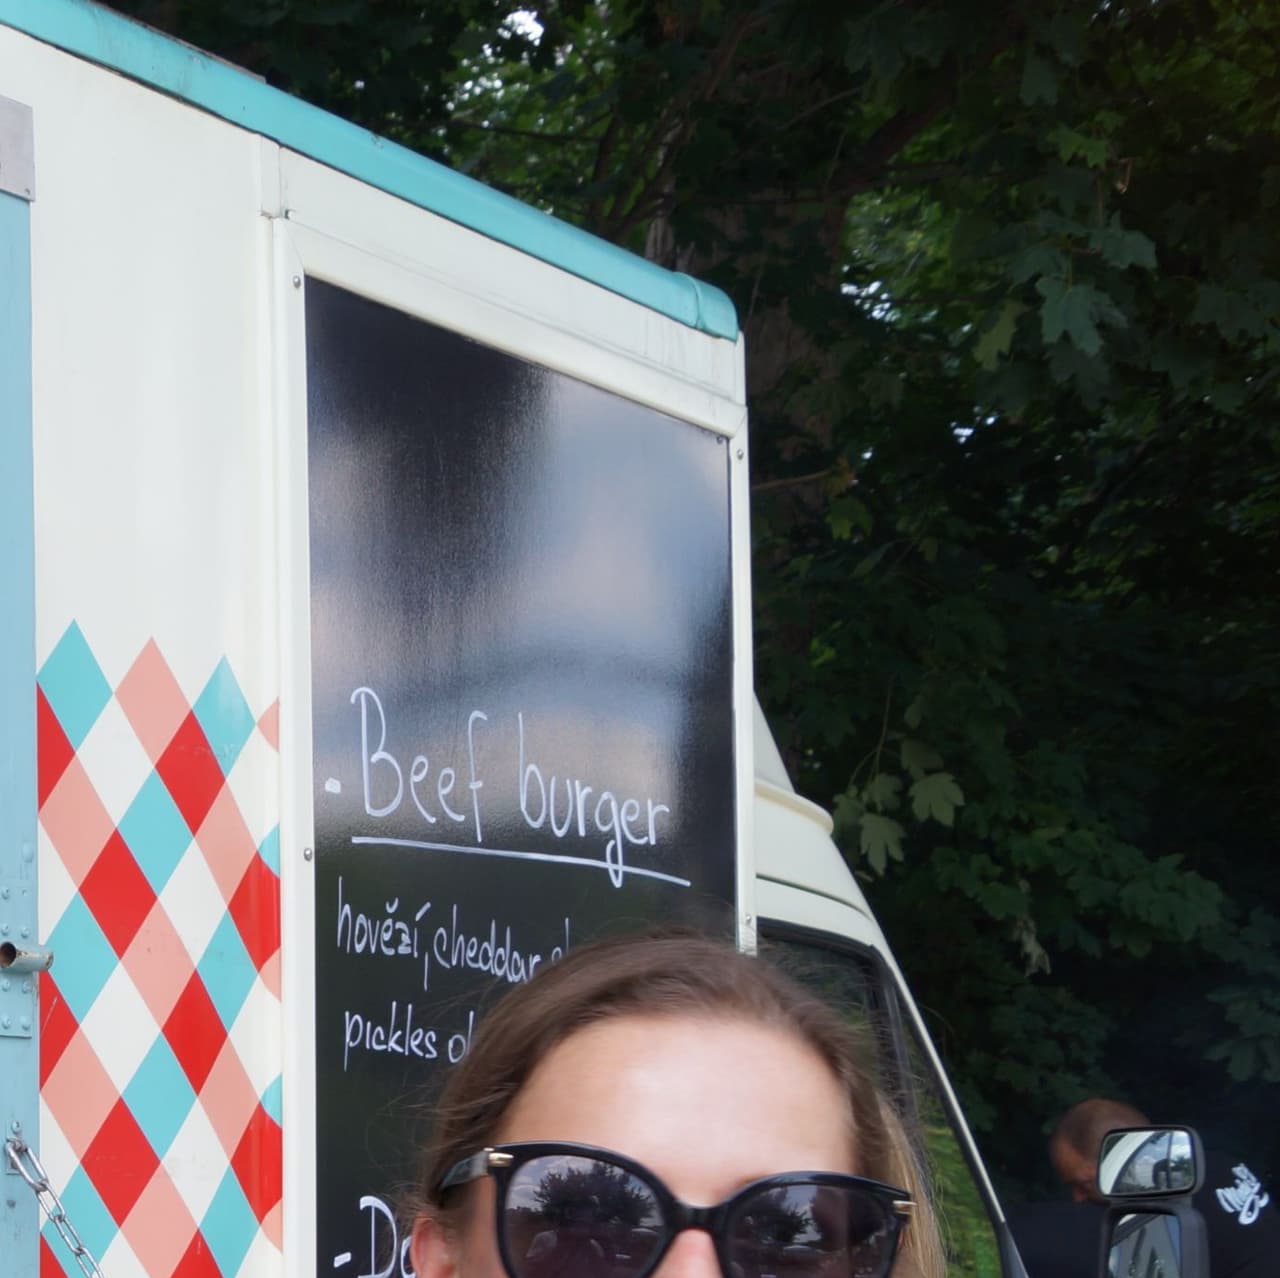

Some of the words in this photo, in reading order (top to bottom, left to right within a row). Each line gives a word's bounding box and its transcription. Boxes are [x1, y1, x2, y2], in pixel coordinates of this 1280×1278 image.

[350, 686, 488, 843] Beef
[518, 711, 670, 889] burger
[344, 1000, 438, 1072] pickles
